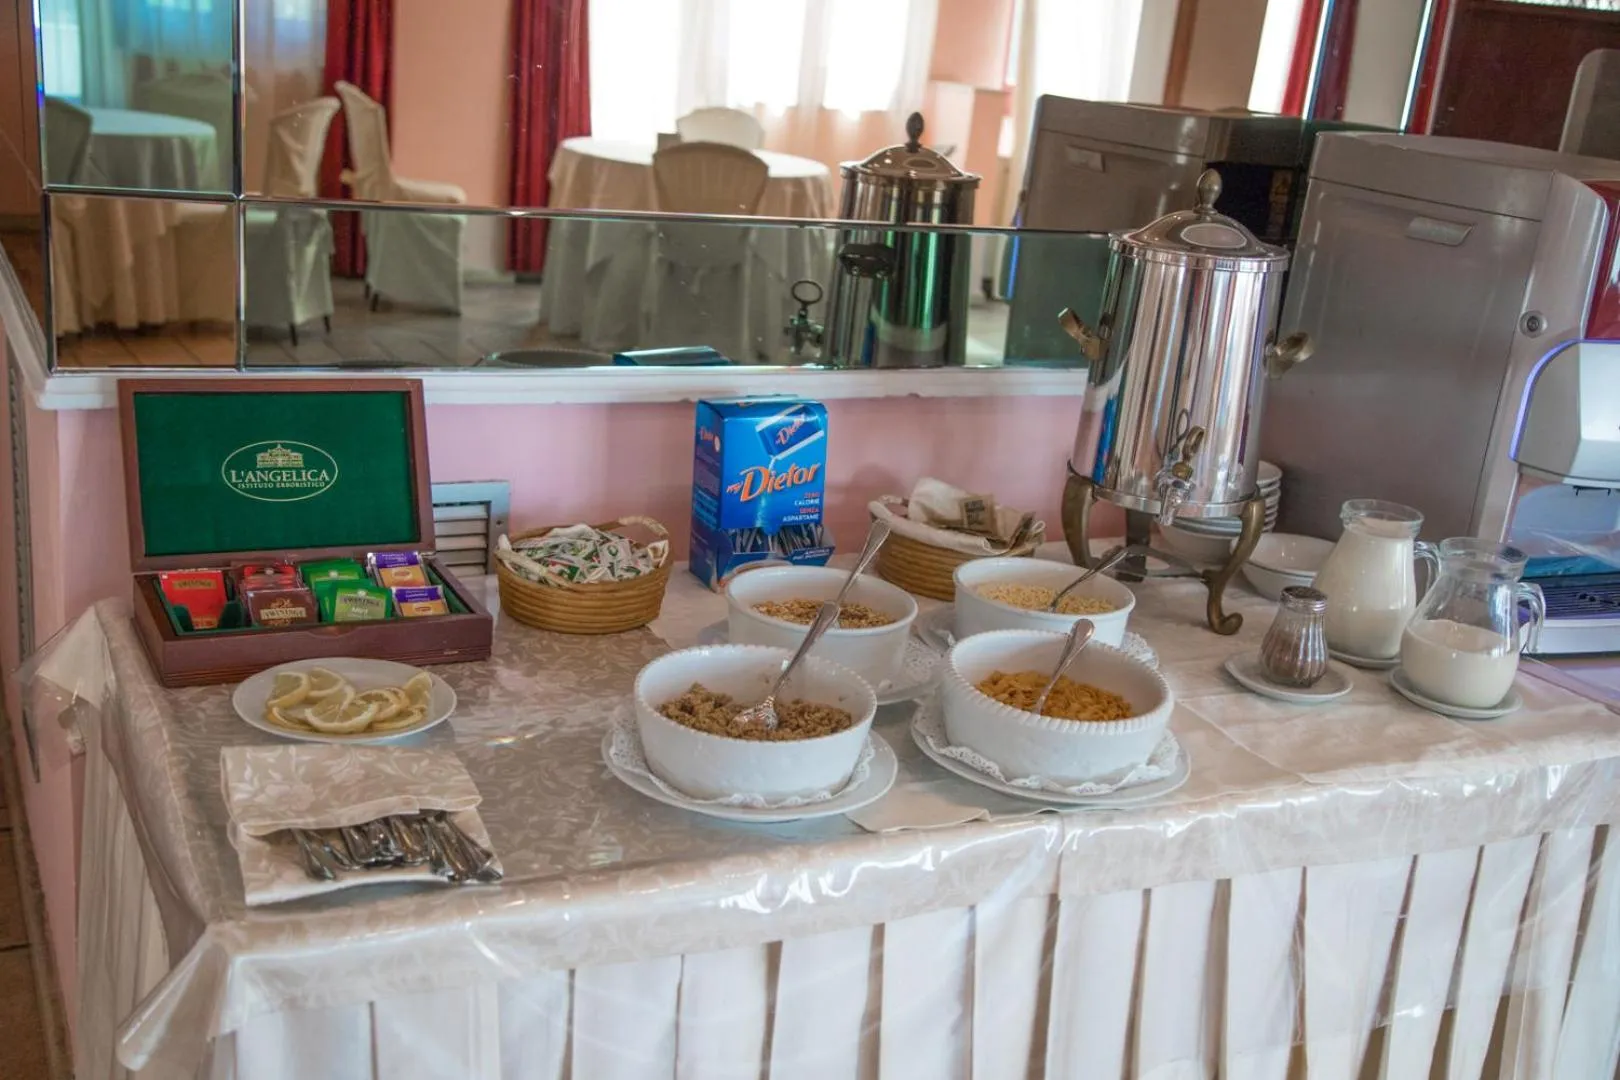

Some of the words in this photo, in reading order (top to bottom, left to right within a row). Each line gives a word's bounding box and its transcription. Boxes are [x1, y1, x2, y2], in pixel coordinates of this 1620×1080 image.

[230, 469, 330, 483] L'ANGELICA
[740, 463, 821, 502] Dietor
[782, 514, 819, 522] ASPARTAME
